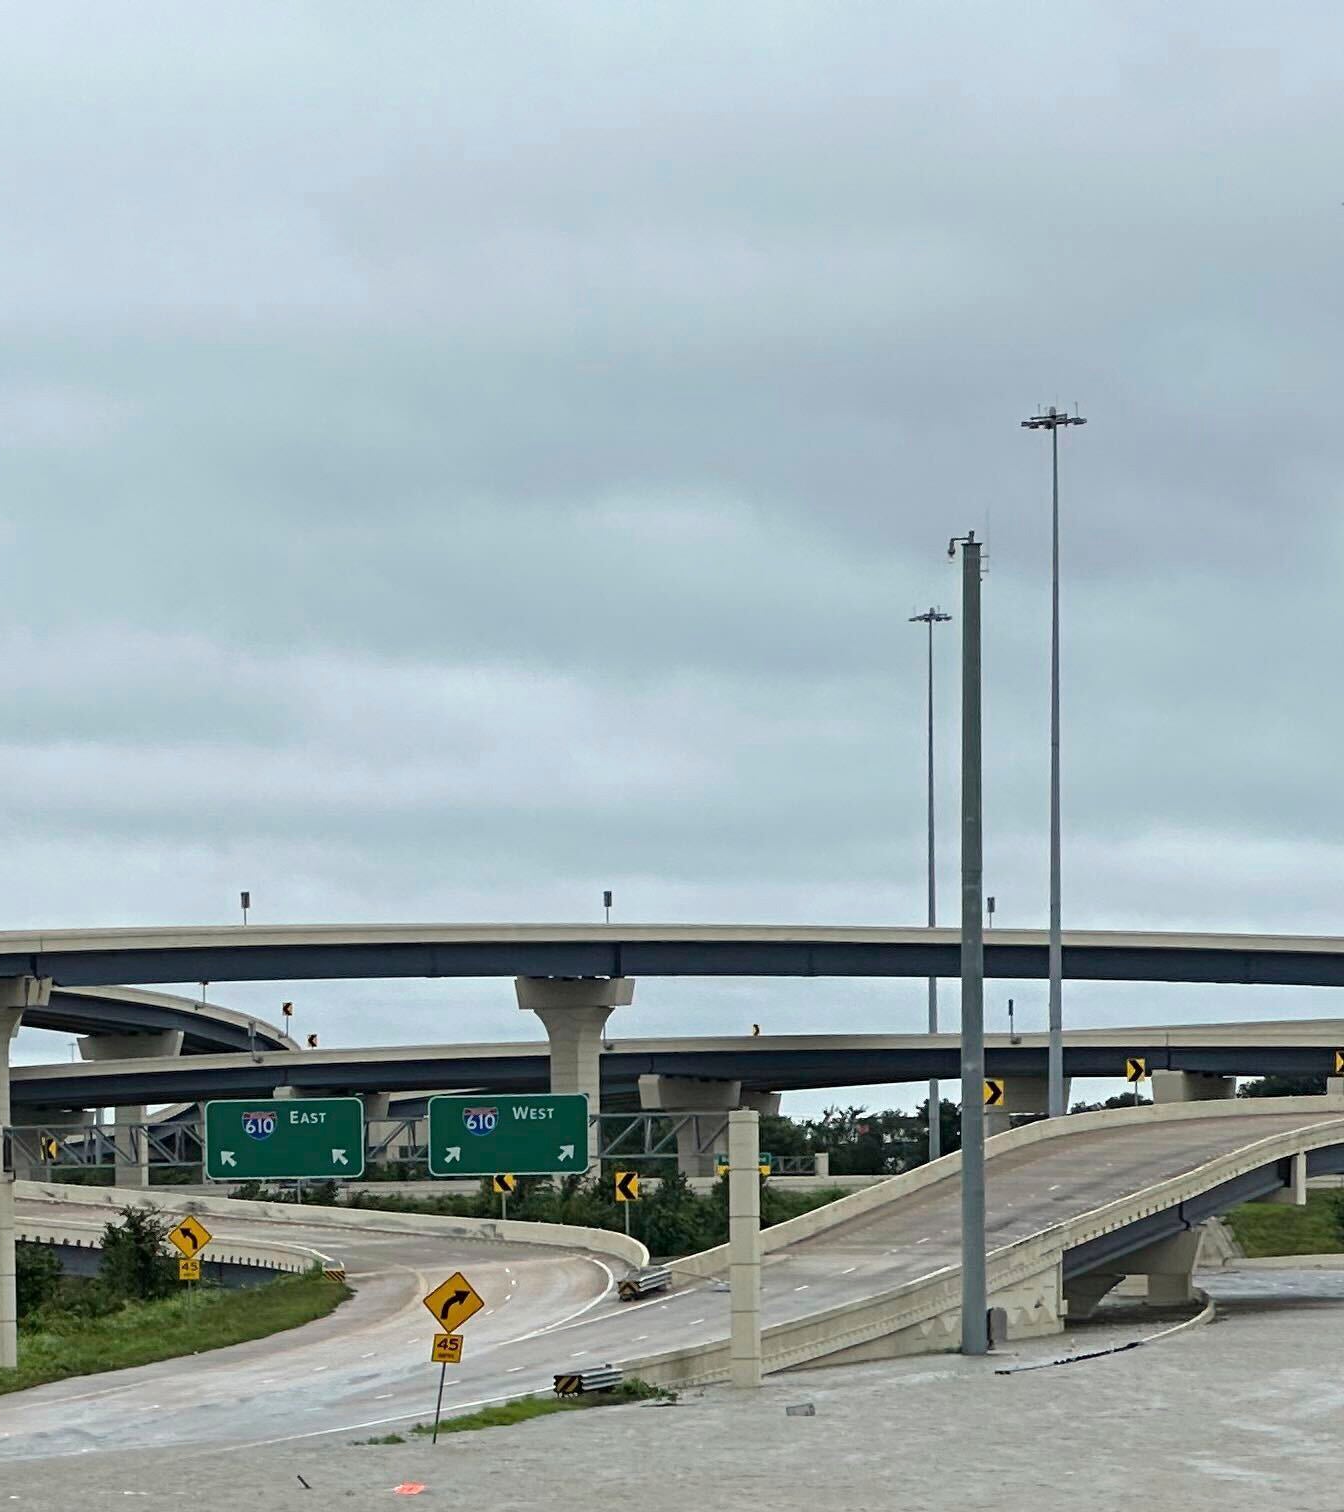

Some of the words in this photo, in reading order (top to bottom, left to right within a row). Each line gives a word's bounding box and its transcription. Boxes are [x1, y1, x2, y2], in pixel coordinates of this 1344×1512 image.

[245, 1118, 274, 1134] 610
[289, 1110, 327, 1124] EAST
[466, 1113, 496, 1130] 610
[512, 1106, 555, 1120] WEST
[182, 1262, 198, 1271] 45
[437, 1338, 459, 1351] 45
